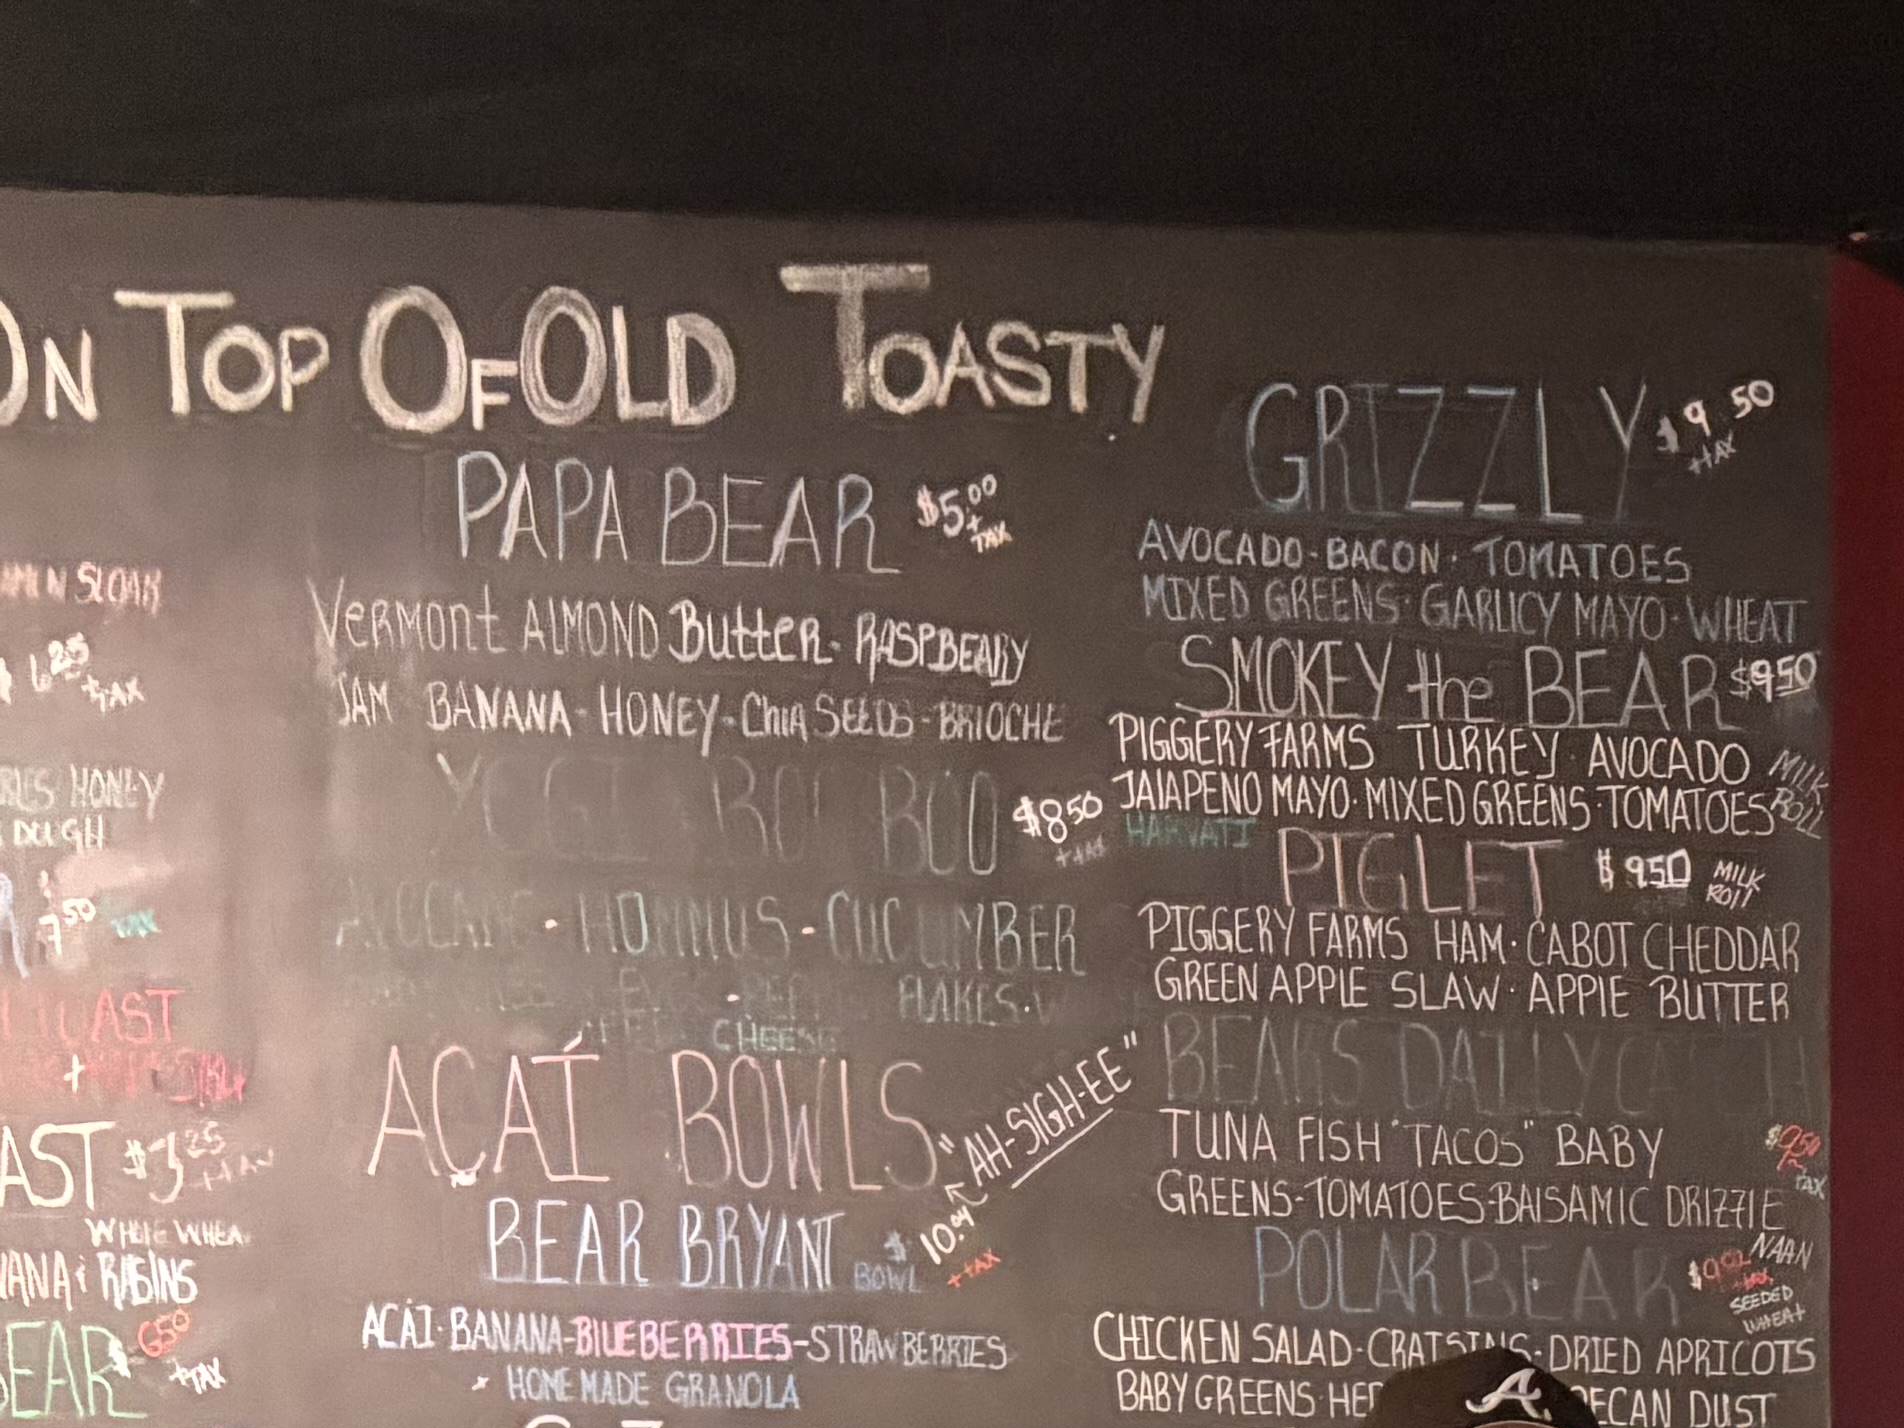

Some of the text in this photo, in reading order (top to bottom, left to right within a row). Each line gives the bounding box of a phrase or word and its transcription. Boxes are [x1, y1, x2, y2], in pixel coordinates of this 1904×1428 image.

[0, 305, 97, 425] N
[1247, 376, 1647, 522] GRIZZLY
[457, 451, 627, 560] PAPA
[661, 467, 900, 574] BEAR
[1138, 519, 1691, 584] AVOCADO BACON TOMATOES
[1142, 573, 1250, 622] MIXED
[1264, 574, 1401, 625] GREENS
[1574, 592, 1667, 641] MAYO
[1686, 596, 1808, 644] WHEAT
[336, 671, 394, 727] JAM
[427, 680, 573, 738] BANANA
[600, 683, 720, 757] HONEY
[1175, 633, 1395, 720] SMOKEY
[1525, 646, 1744, 731] BEAR
[1109, 711, 1750, 785] PIGGERY FARMS TURKEY AVOCADO
[1768, 750, 1830, 806] MILK
[69, 763, 165, 824] HONEY
[1271, 773, 1351, 820] MAYO
[1364, 777, 1466, 827] MIXED
[1473, 779, 1591, 832] GREENS
[1597, 783, 1776, 837] TOMATOES
[1278, 826, 1565, 921] PIGLET
[1713, 860, 1767, 893] MILK
[1138, 901, 1800, 975] PIGGERY FARMS HAM CABOT CHEDDAR
[1154, 956, 1258, 1003] GREEN
[1269, 964, 1369, 1008] APPLE
[1391, 971, 1502, 1013] SLAW
[1648, 974, 1790, 1023] BUTTER
[672, 1049, 938, 1192] BOWLS
[1159, 1109, 1277, 1163] TUNA
[1299, 1117, 1381, 1163] FISH
[1556, 1123, 1664, 1180] BABY
[1156, 1168, 1293, 1218] GREENS
[1304, 1176, 1485, 1225] TOMATOES
[485, 1197, 845, 1292] BEAR BRYANT
[1255, 1225, 1443, 1315] POLAR
[1461, 1235, 1682, 1328] BEAR
[1729, 1284, 1795, 1315] SEEDED
[1093, 1310, 1240, 1364] CHICKEN
[1251, 1322, 1353, 1367] SALAD
[1550, 1334, 1642, 1375] DRIED
[1656, 1338, 1816, 1377] APRICOTS
[665, 1371, 800, 1410] GRANOLA
[1117, 1368, 1188, 1413] BABY
[1195, 1375, 1315, 1417] GREENS
[1690, 1390, 1778, 1428] DUST
[1465, 1368, 1553, 1422] A
